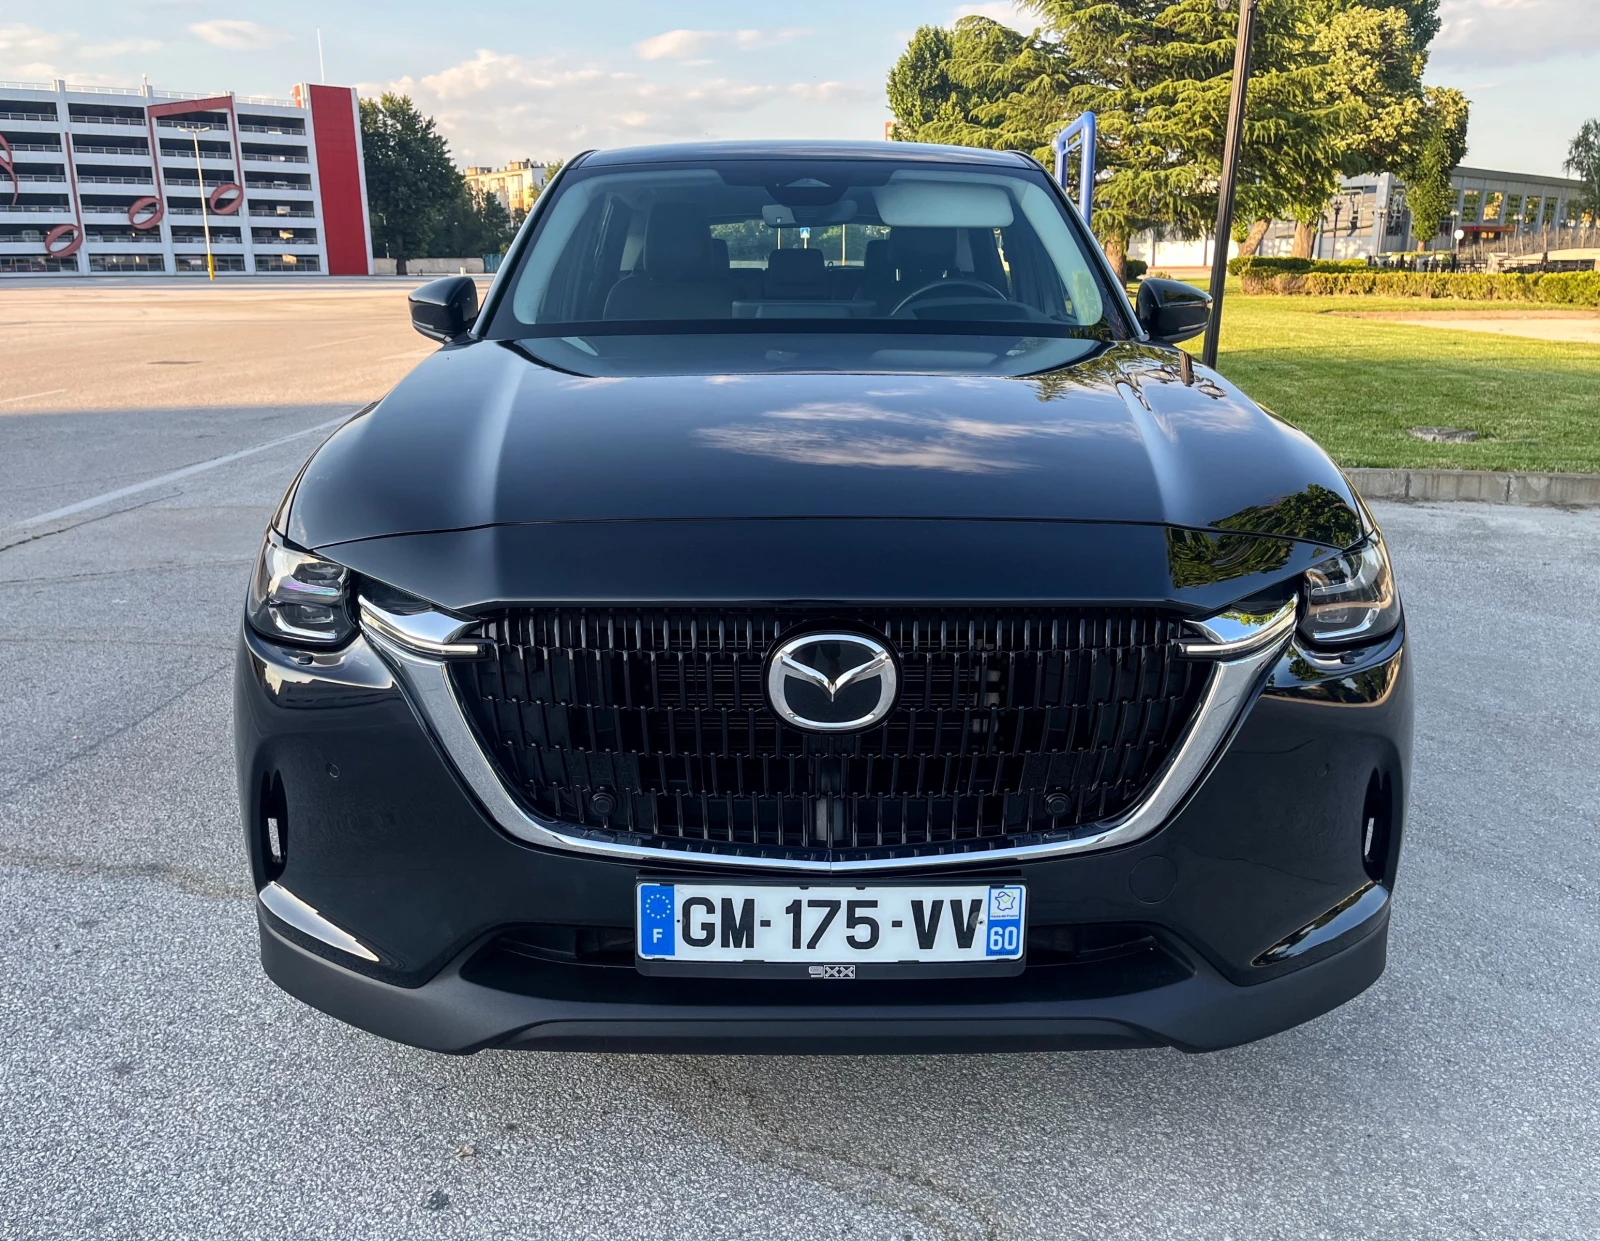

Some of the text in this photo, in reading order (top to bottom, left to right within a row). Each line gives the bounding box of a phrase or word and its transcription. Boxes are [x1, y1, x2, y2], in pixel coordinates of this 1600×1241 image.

[682, 896, 983, 950] GM-175-VV
[652, 928, 663, 943] F
[989, 926, 1018, 950] 60
